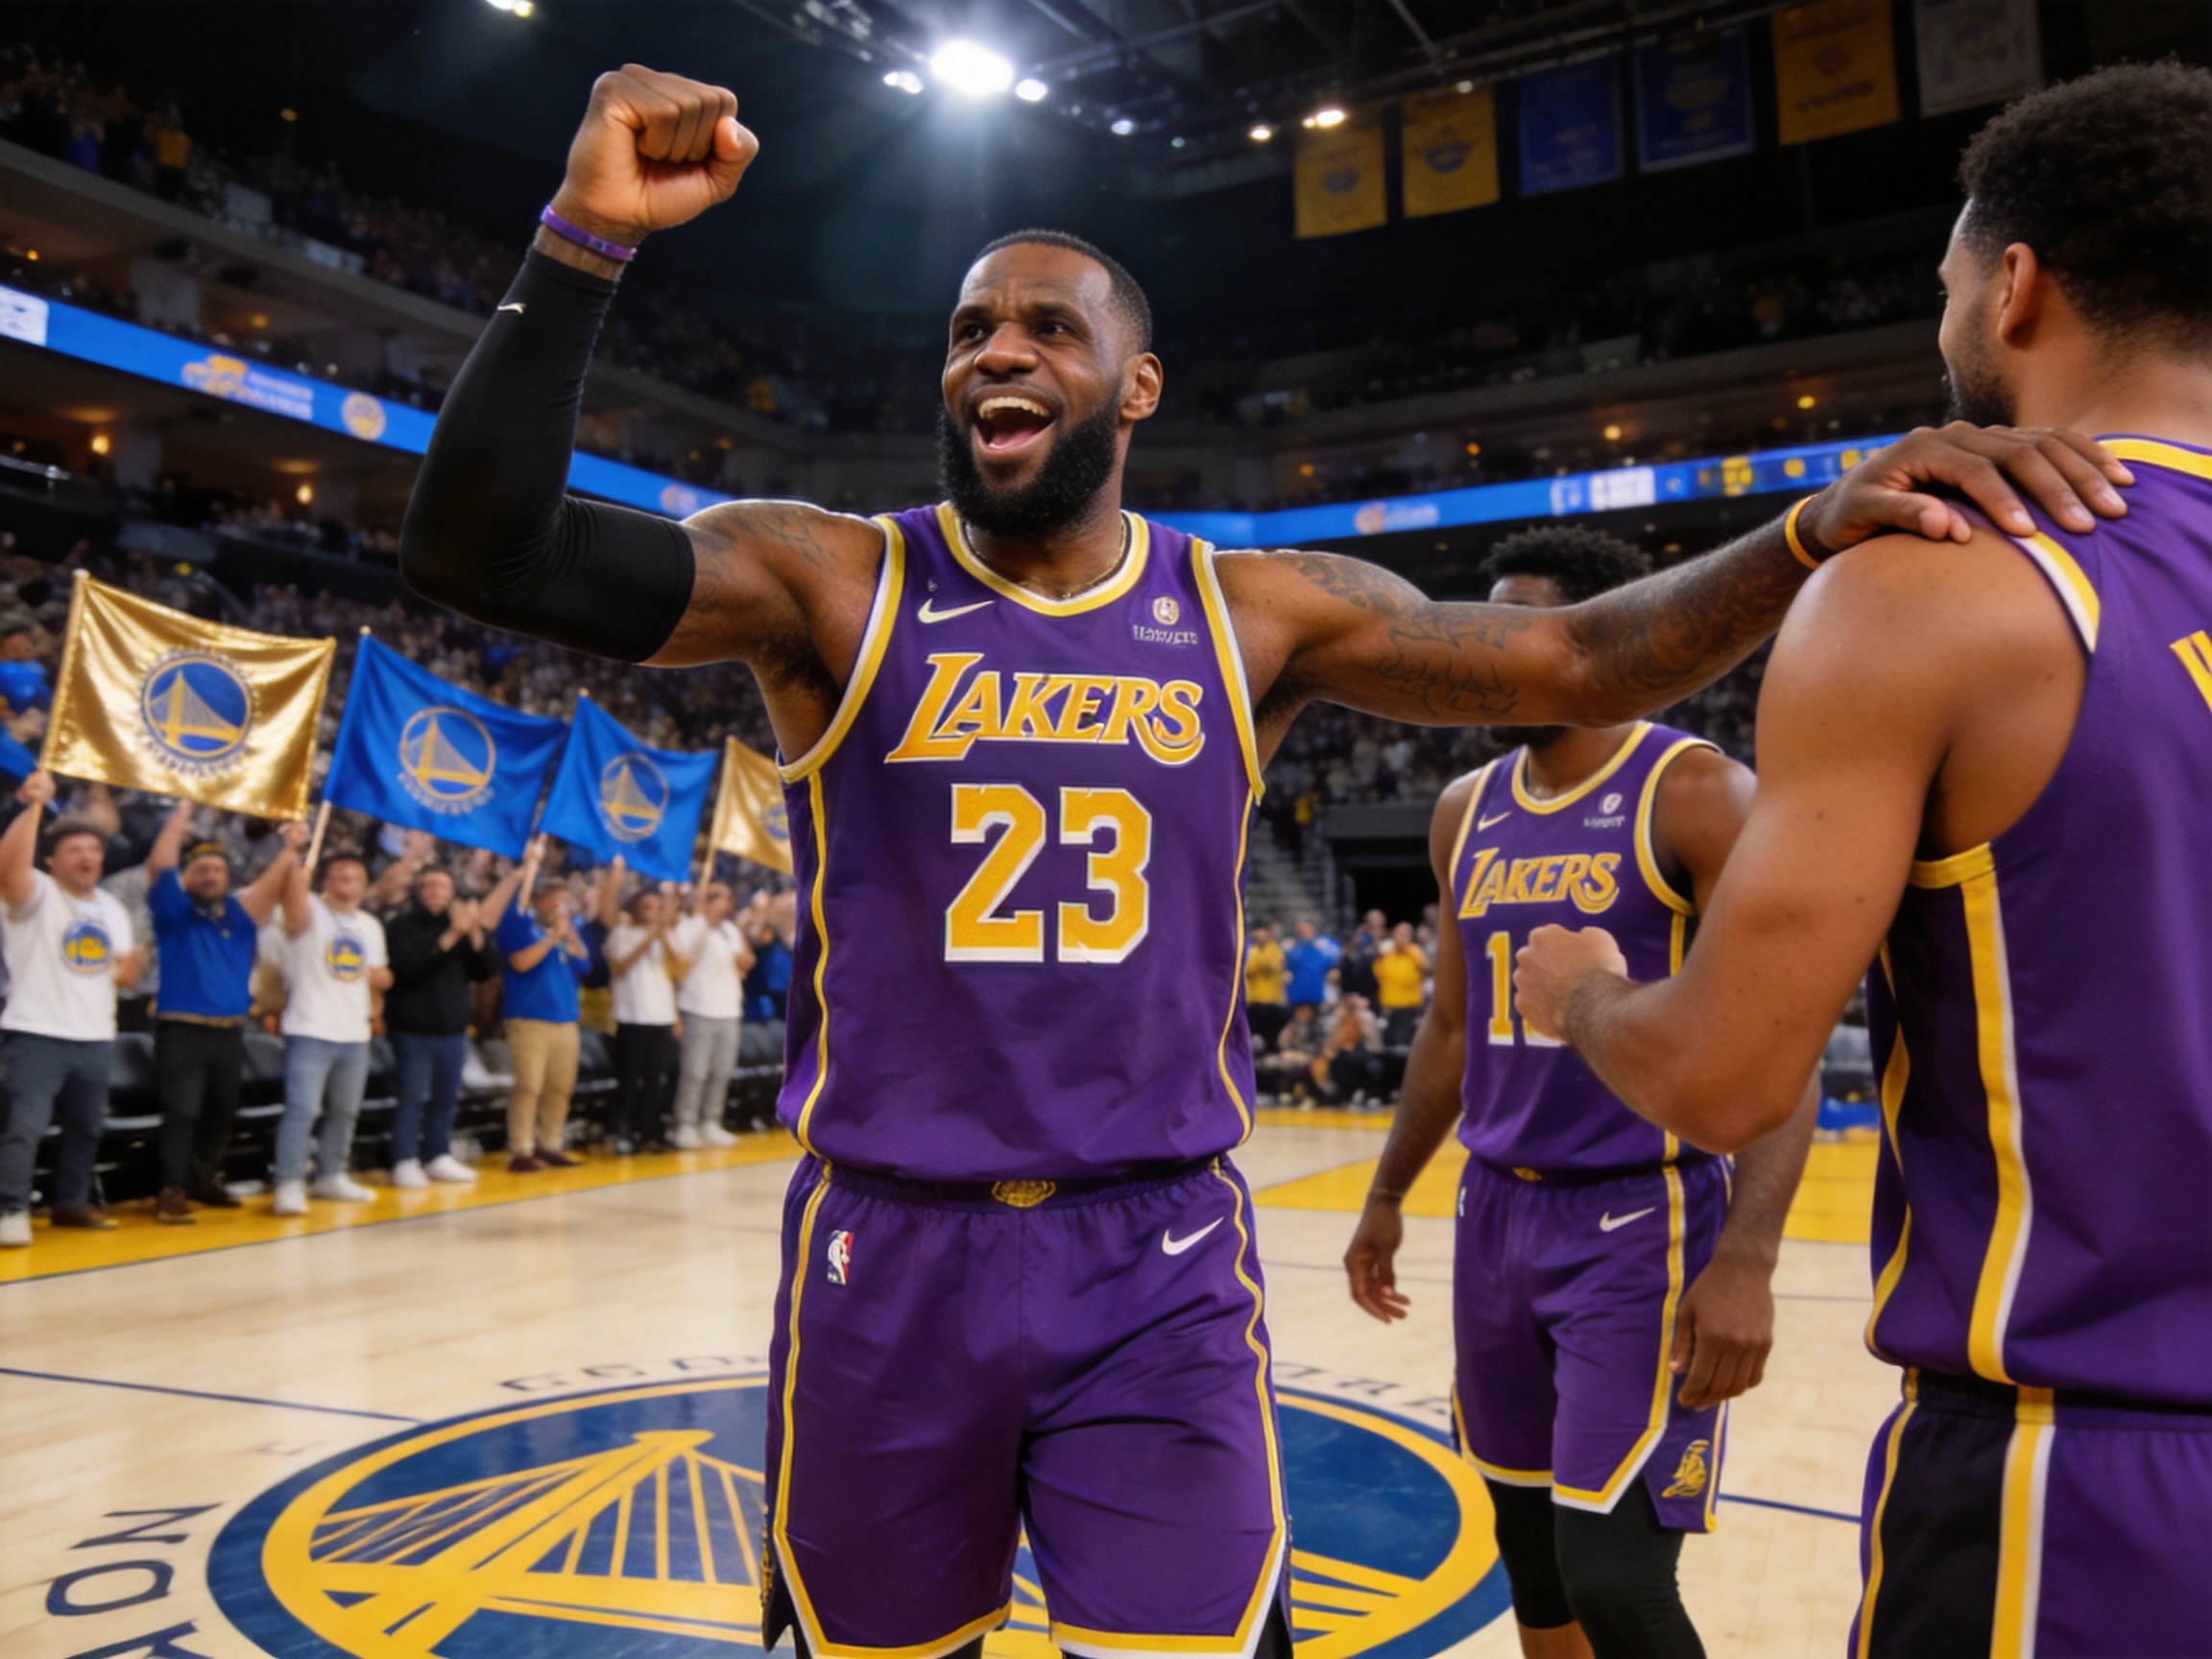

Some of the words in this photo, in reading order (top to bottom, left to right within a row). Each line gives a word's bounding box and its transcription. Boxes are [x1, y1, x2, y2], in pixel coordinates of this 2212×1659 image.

[883, 652, 1206, 765] LAKERS
[945, 783, 1152, 964] 23
[1457, 847, 1622, 920] LAKERS
